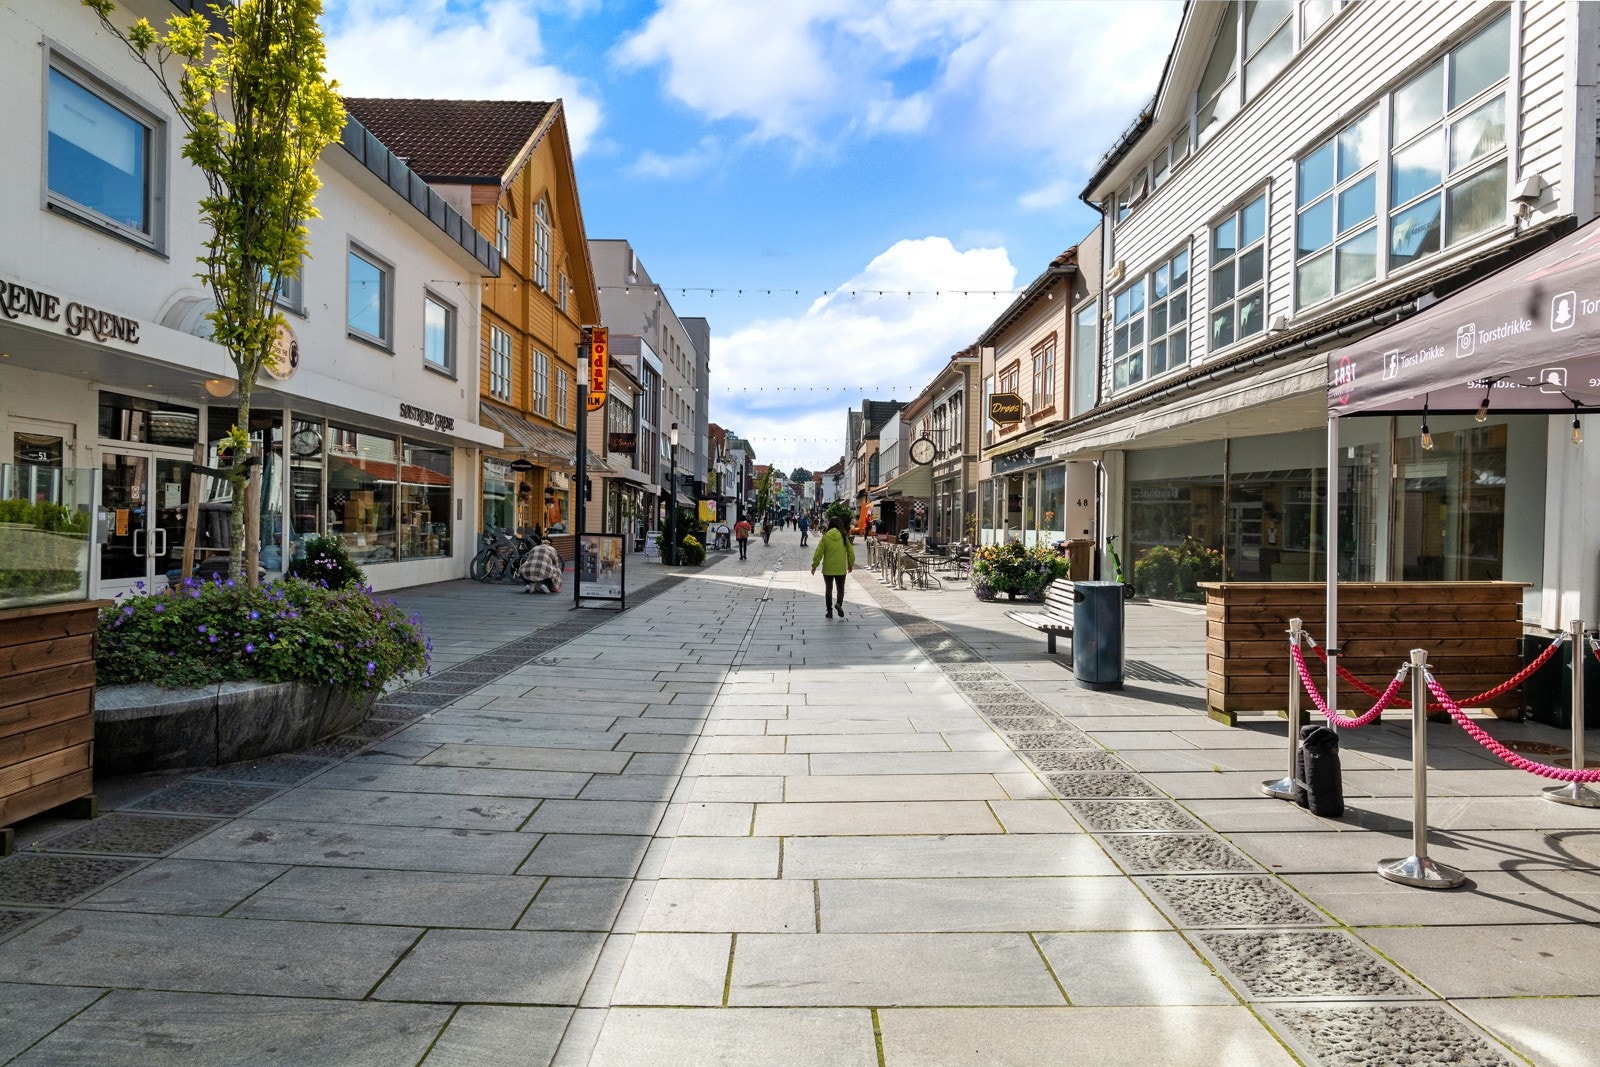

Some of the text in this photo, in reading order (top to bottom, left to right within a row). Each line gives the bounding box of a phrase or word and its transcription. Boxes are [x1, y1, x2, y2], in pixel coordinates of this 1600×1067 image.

[66, 302, 140, 344] GRENE
[1479, 318, 1532, 344] Torstdrikke
[593, 330, 606, 391] Kodak
[1401, 345, 1445, 369] Tørst Drikke
[587, 397, 600, 405] ILM
[992, 402, 1020, 414] Drøøs
[400, 403, 454, 432] SØSTRENE GRENE
[38, 451, 47, 460] 51
[1076, 498, 1088, 507] 48
